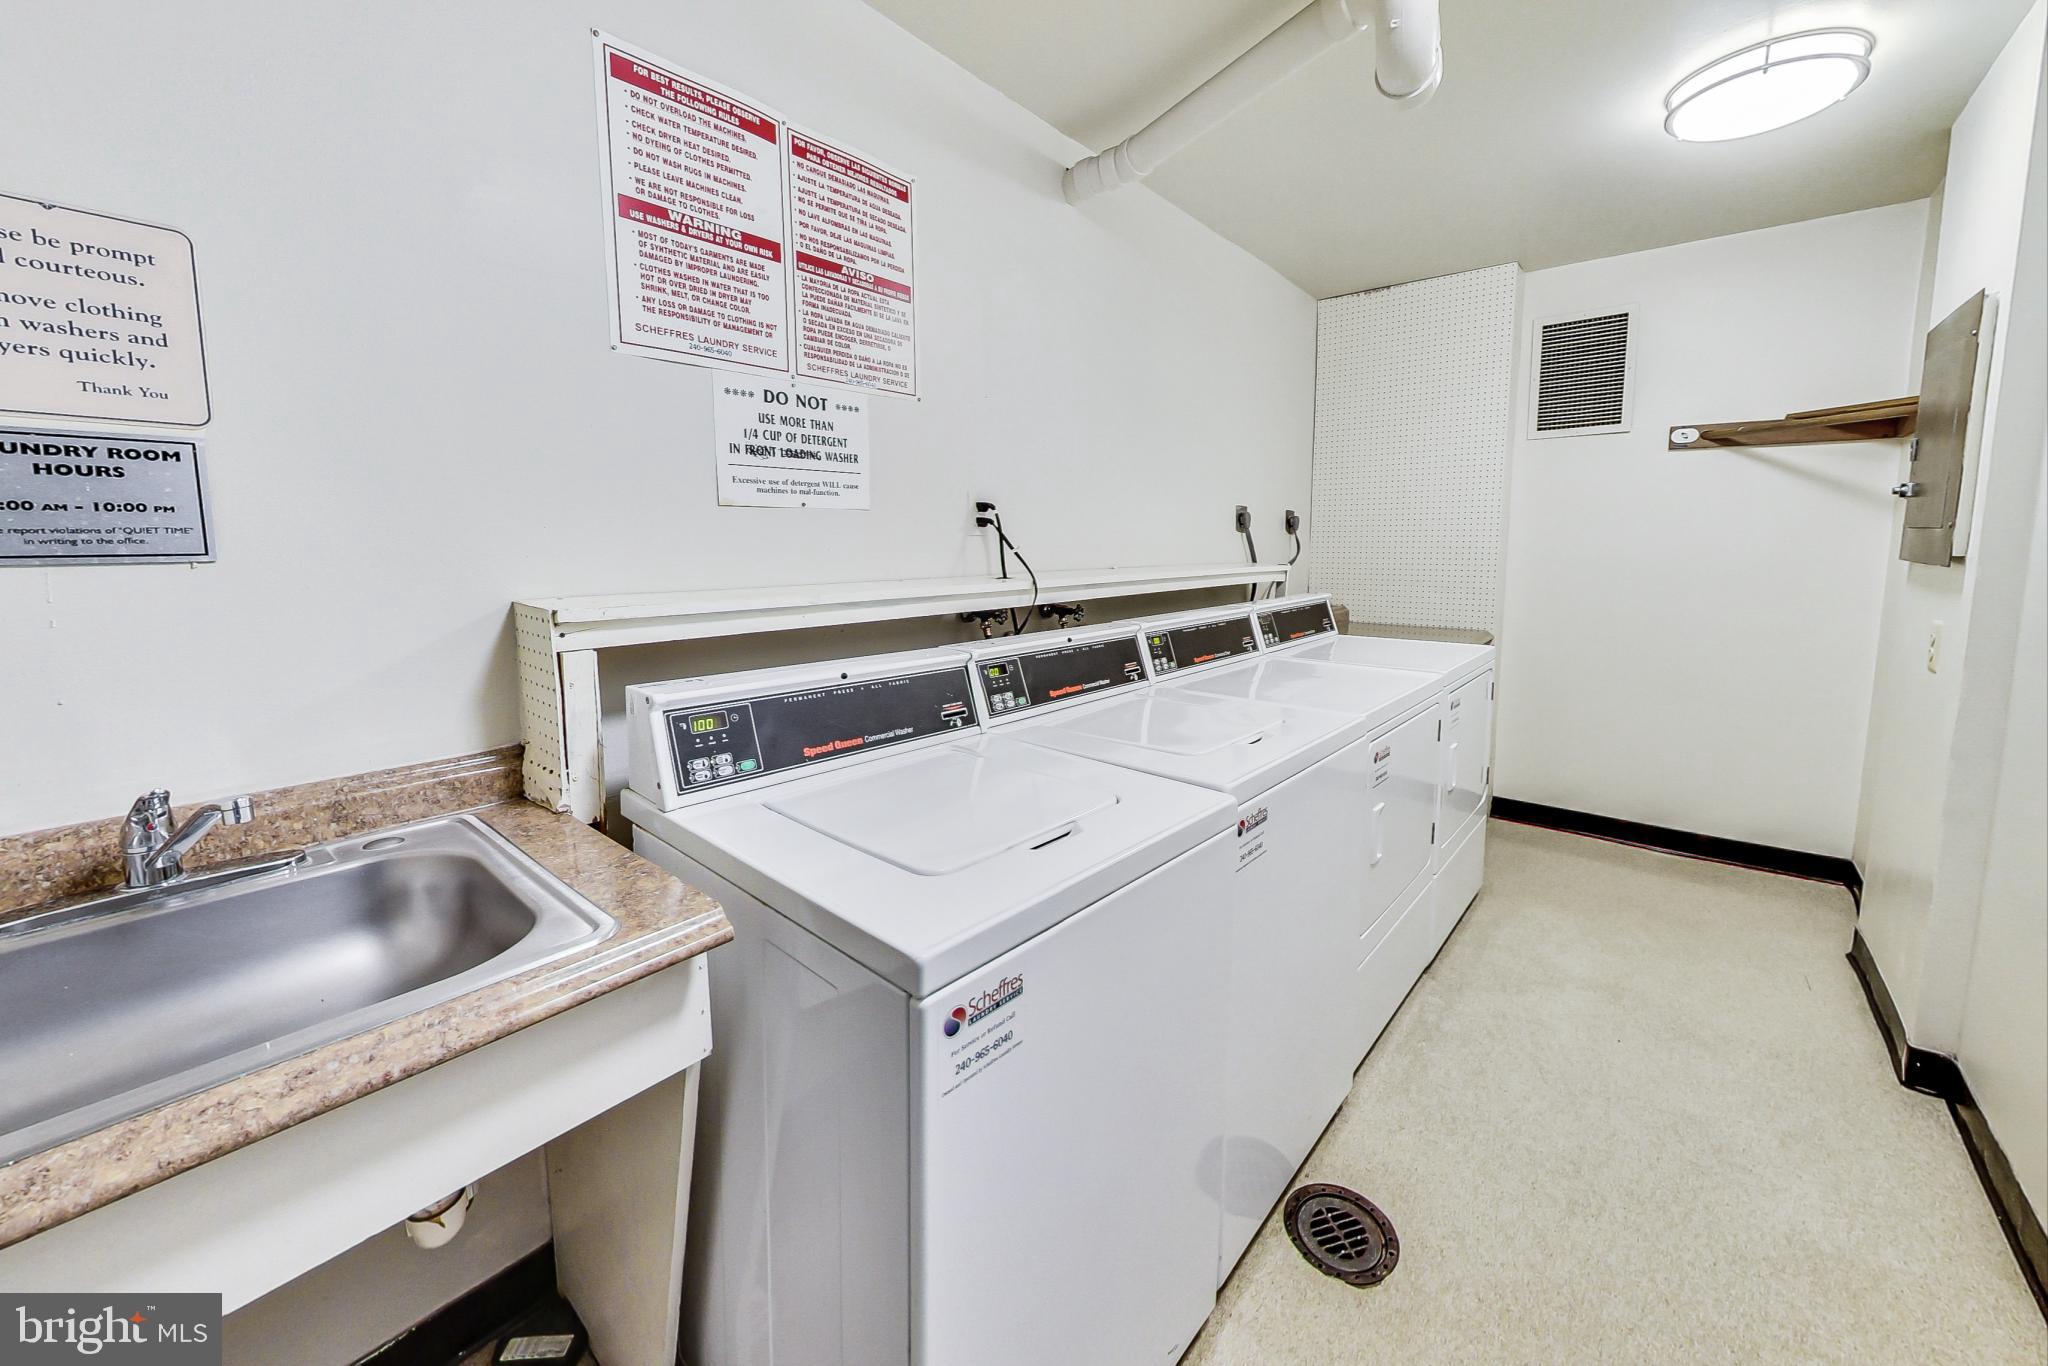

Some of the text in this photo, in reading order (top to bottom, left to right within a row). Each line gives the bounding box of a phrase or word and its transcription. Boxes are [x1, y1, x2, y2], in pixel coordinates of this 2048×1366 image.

[630, 88, 640, 100] DO
[642, 93, 657, 106] NOT
[660, 101, 696, 122] OVERLOAD
[699, 116, 711, 128] THE
[633, 64, 648, 77] FOR
[650, 71, 668, 86] BEST
[705, 95, 730, 112] PLEASE
[732, 107, 760, 125] OBSERVE
[660, 86, 739, 127] THE FOLLOWING RULES
[630, 104, 654, 120] CHECK
[657, 114, 680, 130] WATER
[683, 125, 728, 149] TEMPERATURE
[631, 119, 655, 135] CHECK
[658, 129, 681, 144] DRYER
[683, 139, 700, 151] HEAT
[632, 131, 642, 141] NO
[645, 136, 671, 152] DYEING
[674, 146, 682, 156] OF
[684, 150, 714, 167] CLOTHES
[632, 146, 643, 156] DO
[645, 151, 659, 162] NOT
[662, 156, 681, 169] WASH
[684, 164, 701, 176] RUGS
[704, 171, 710, 180] IN
[633, 161, 660, 176] PLEASE
[662, 171, 683, 184] LEAVE
[686, 179, 718, 196] MACHINES
[668, 208, 741, 240] WARNING
[31, 229, 61, 248] be
[70, 242, 156, 266] prompt
[637, 229, 765, 271] MOST OF TODAY'S GARMENTS ARE MADE
[638, 240, 769, 281] OF SYNTHETIC MATERIAL AND ARE EASILY
[15, 256, 145, 287] courteous.
[841, 266, 874, 282] AVISO
[66, 298, 162, 328] clothing
[20, 321, 119, 341] washers
[128, 333, 168, 347] and
[635, 322, 777, 357] SCHEFFRES LAUNDRY SERVICE
[60, 347, 156, 371] quickly.
[807, 363, 848, 377] SCHEFFRES
[850, 371, 880, 383] LAUNDRY
[882, 378, 907, 388] SERVICE
[77, 381, 169, 400] Thank You
[764, 389, 828, 411] DO NOT
[758, 413, 834, 431] USE MORE THAN
[744, 428, 847, 448] 1/4 CUP OF DETERGENT
[107, 448, 181, 462] ROOM
[729, 443, 740, 454] IN
[825, 451, 859, 463] WASHER
[32, 463, 125, 477] HOURS
[732, 476, 766, 485] Excessive
[791, 480, 820, 488] detergent
[822, 481, 840, 489] WILL
[799, 488, 840, 496] mal-function.
[41, 503, 68, 511] AM
[93, 502, 148, 512] 10:00
[7, 527, 46, 536] report
[49, 526, 101, 534] violations
[37, 538, 78, 546] writing
[694, 719, 714, 732] 100
[803, 726, 914, 757] Speed Queen Commercial Washer
[968, 973, 1023, 1017] Scheffres
